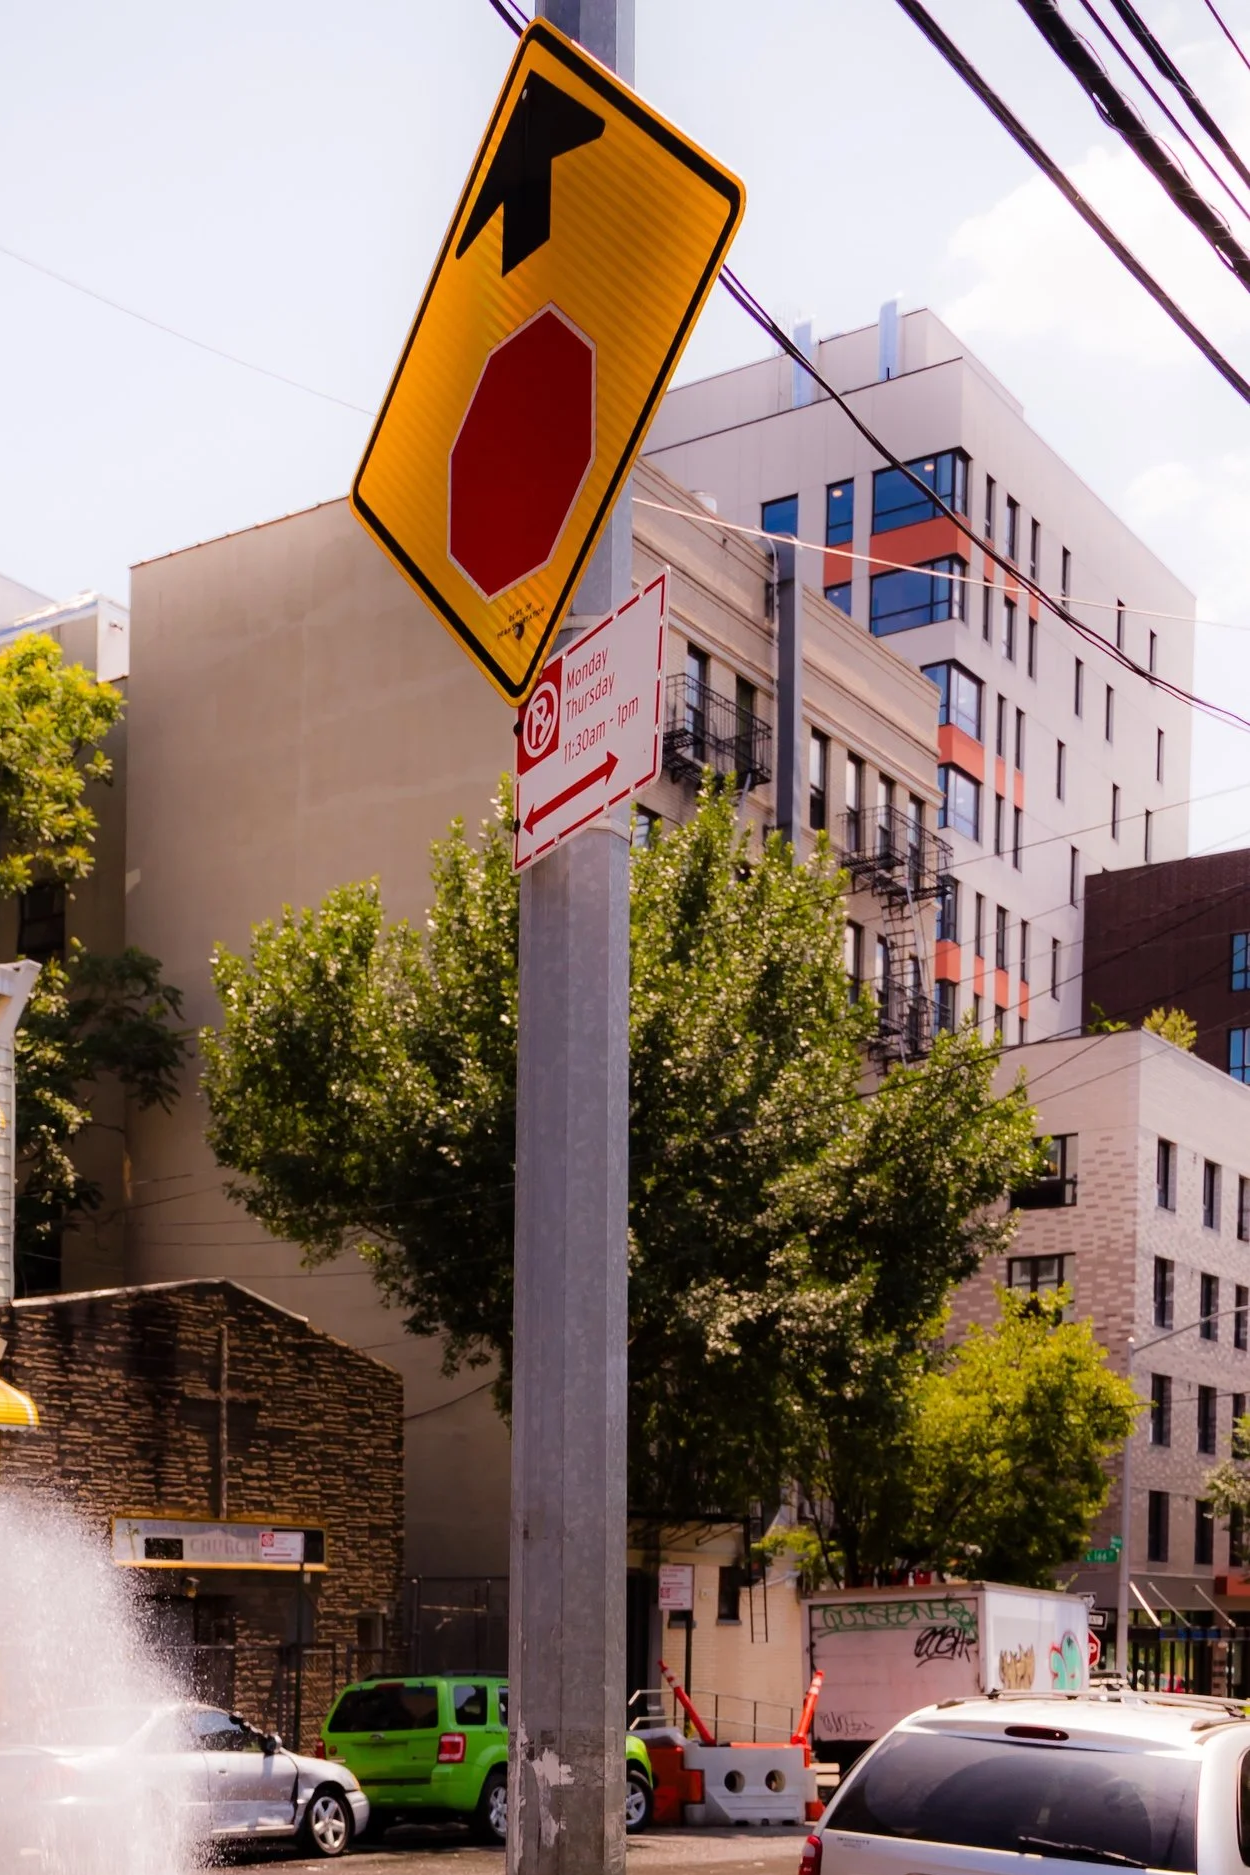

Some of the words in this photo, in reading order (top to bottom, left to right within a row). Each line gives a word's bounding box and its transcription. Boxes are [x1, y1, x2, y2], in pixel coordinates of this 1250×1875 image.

[566, 647, 608, 694] Monday
[565, 671, 615, 723] Thursday
[563, 720, 606, 765] 11:30am
[617, 696, 639, 729] 1pm
